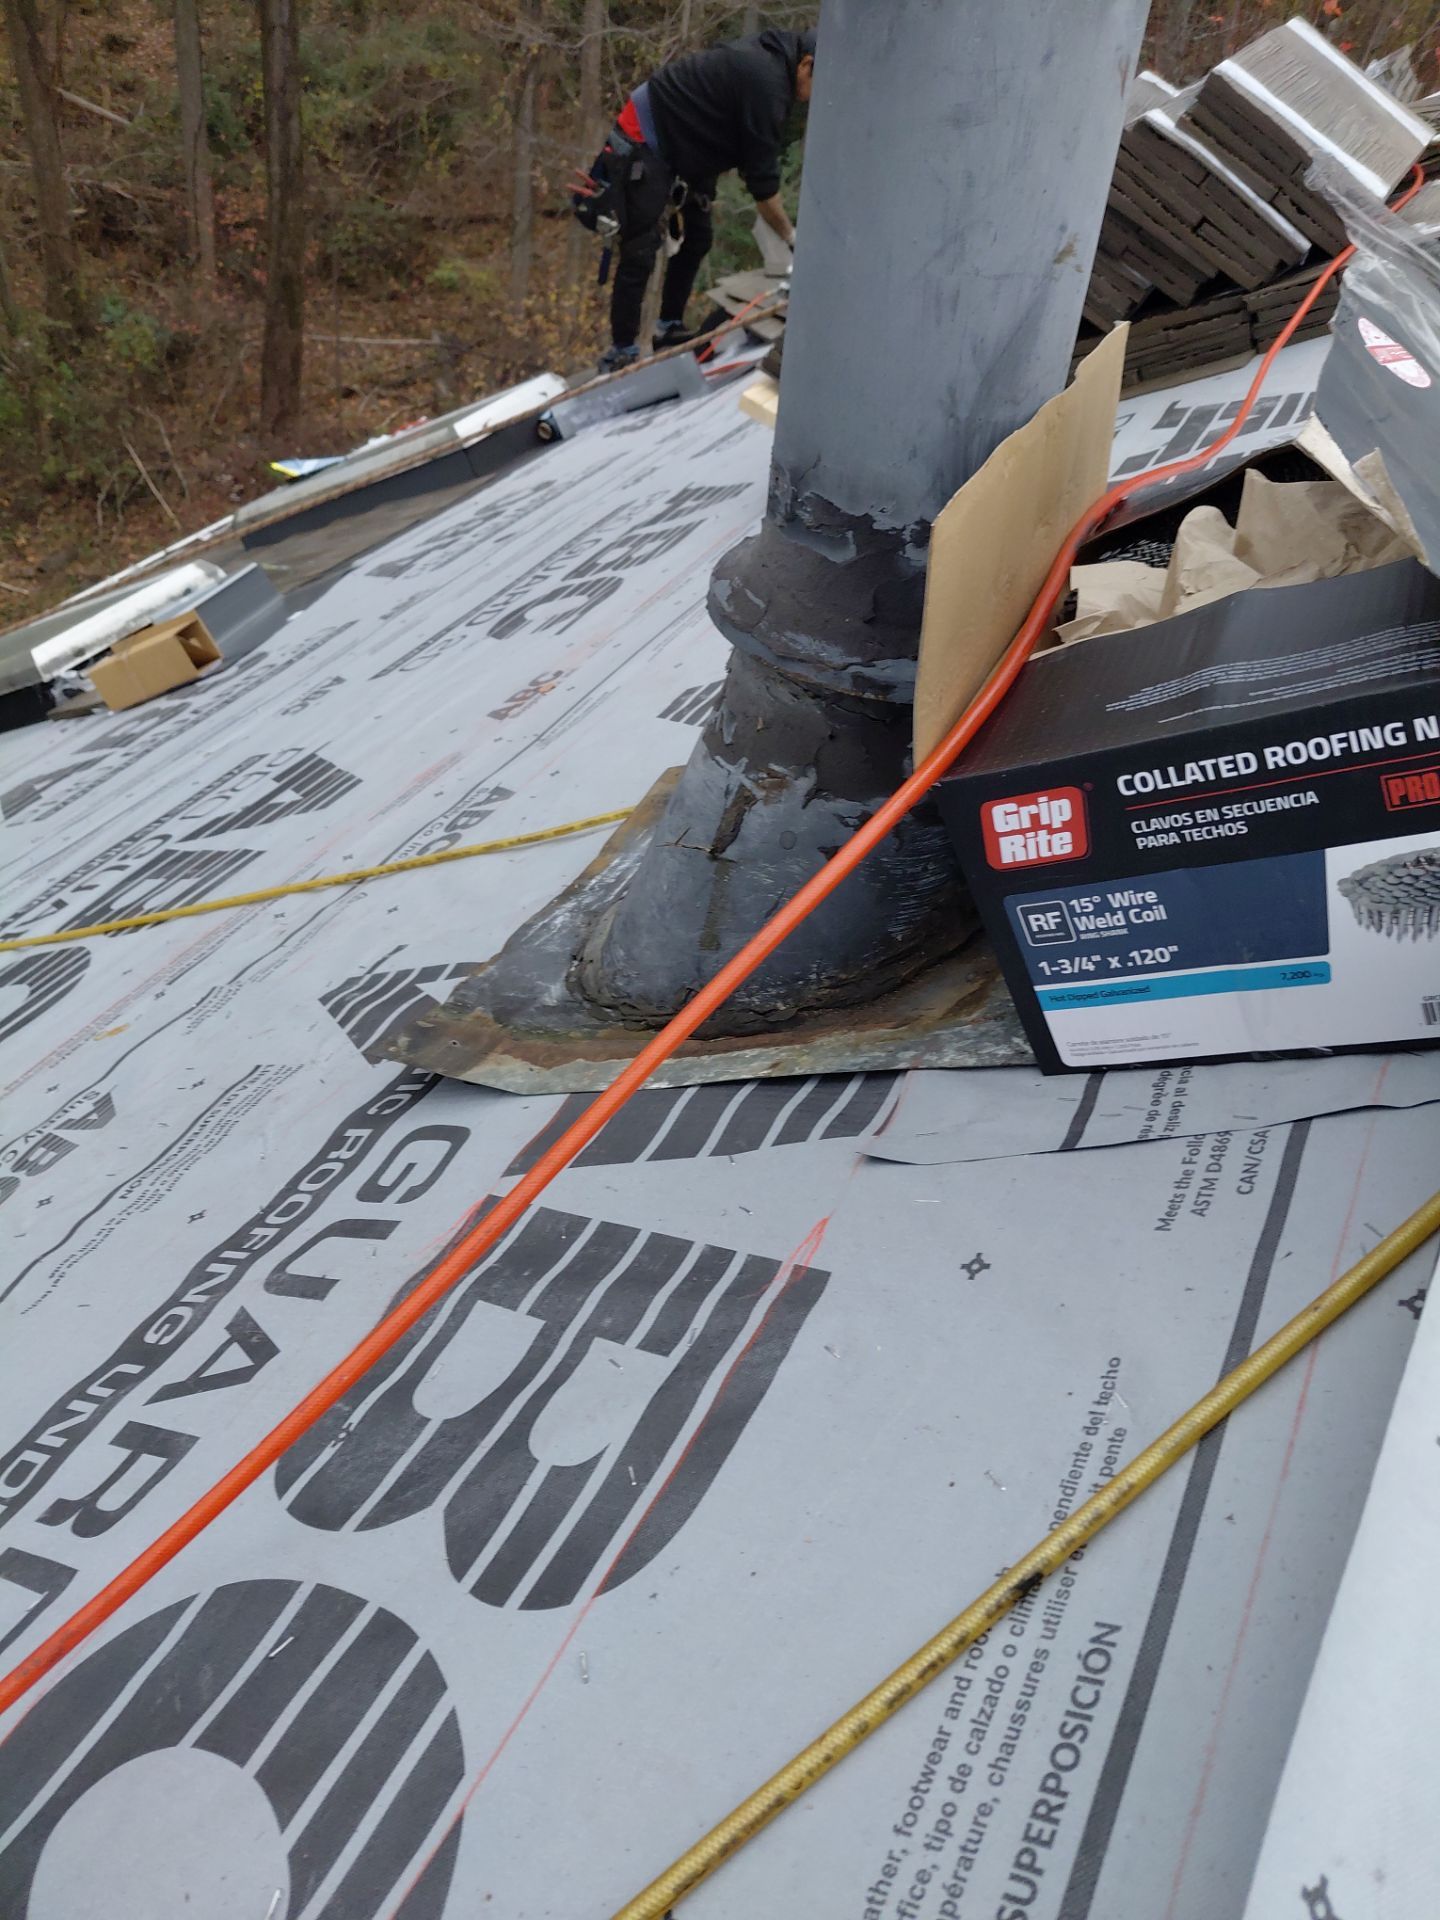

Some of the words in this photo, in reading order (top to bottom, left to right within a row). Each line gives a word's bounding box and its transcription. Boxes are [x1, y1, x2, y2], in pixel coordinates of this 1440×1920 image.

[1116, 751, 1259, 797] COLLATED
[1263, 722, 1407, 770] ROOFING
[991, 796, 1073, 836] Grip
[1131, 812, 1193, 834] CLAVOS
[1194, 807, 1219, 827] EN
[1221, 791, 1320, 820] SECUENCIA
[1136, 830, 1179, 850] PARA
[1181, 821, 1249, 843] TECHOS
[999, 829, 1074, 864] Rite
[1028, 911, 1062, 932] RF
[1073, 912, 1125, 931] Weld
[1129, 905, 1168, 924] Coil
[1106, 890, 1158, 909] Wire
[1038, 954, 1101, 976] 1-3/4"
[1107, 956, 1122, 969] x
[1127, 945, 1179, 967] .120"
[24, 1091, 101, 1144] Supply
[1153, 1193, 1185, 1233] Meets
[1172, 1168, 1194, 1190] the
[1189, 1176, 1219, 1217] ASTM
[144, 1128, 373, 1346] ROOFING
[1081, 1408, 1105, 1436] del
[1093, 1356, 1123, 1405] techo
[1096, 1426, 1128, 1476] pente
[982, 1645, 1051, 1787] chaussures
[1036, 1565, 1079, 1642] utiliser
[958, 1662, 1010, 1756] calzado
[891, 1725, 953, 1837] footwear
[940, 1676, 972, 1720] and
[944, 1762, 973, 1794] de
[921, 1801, 959, 1851] tipo
